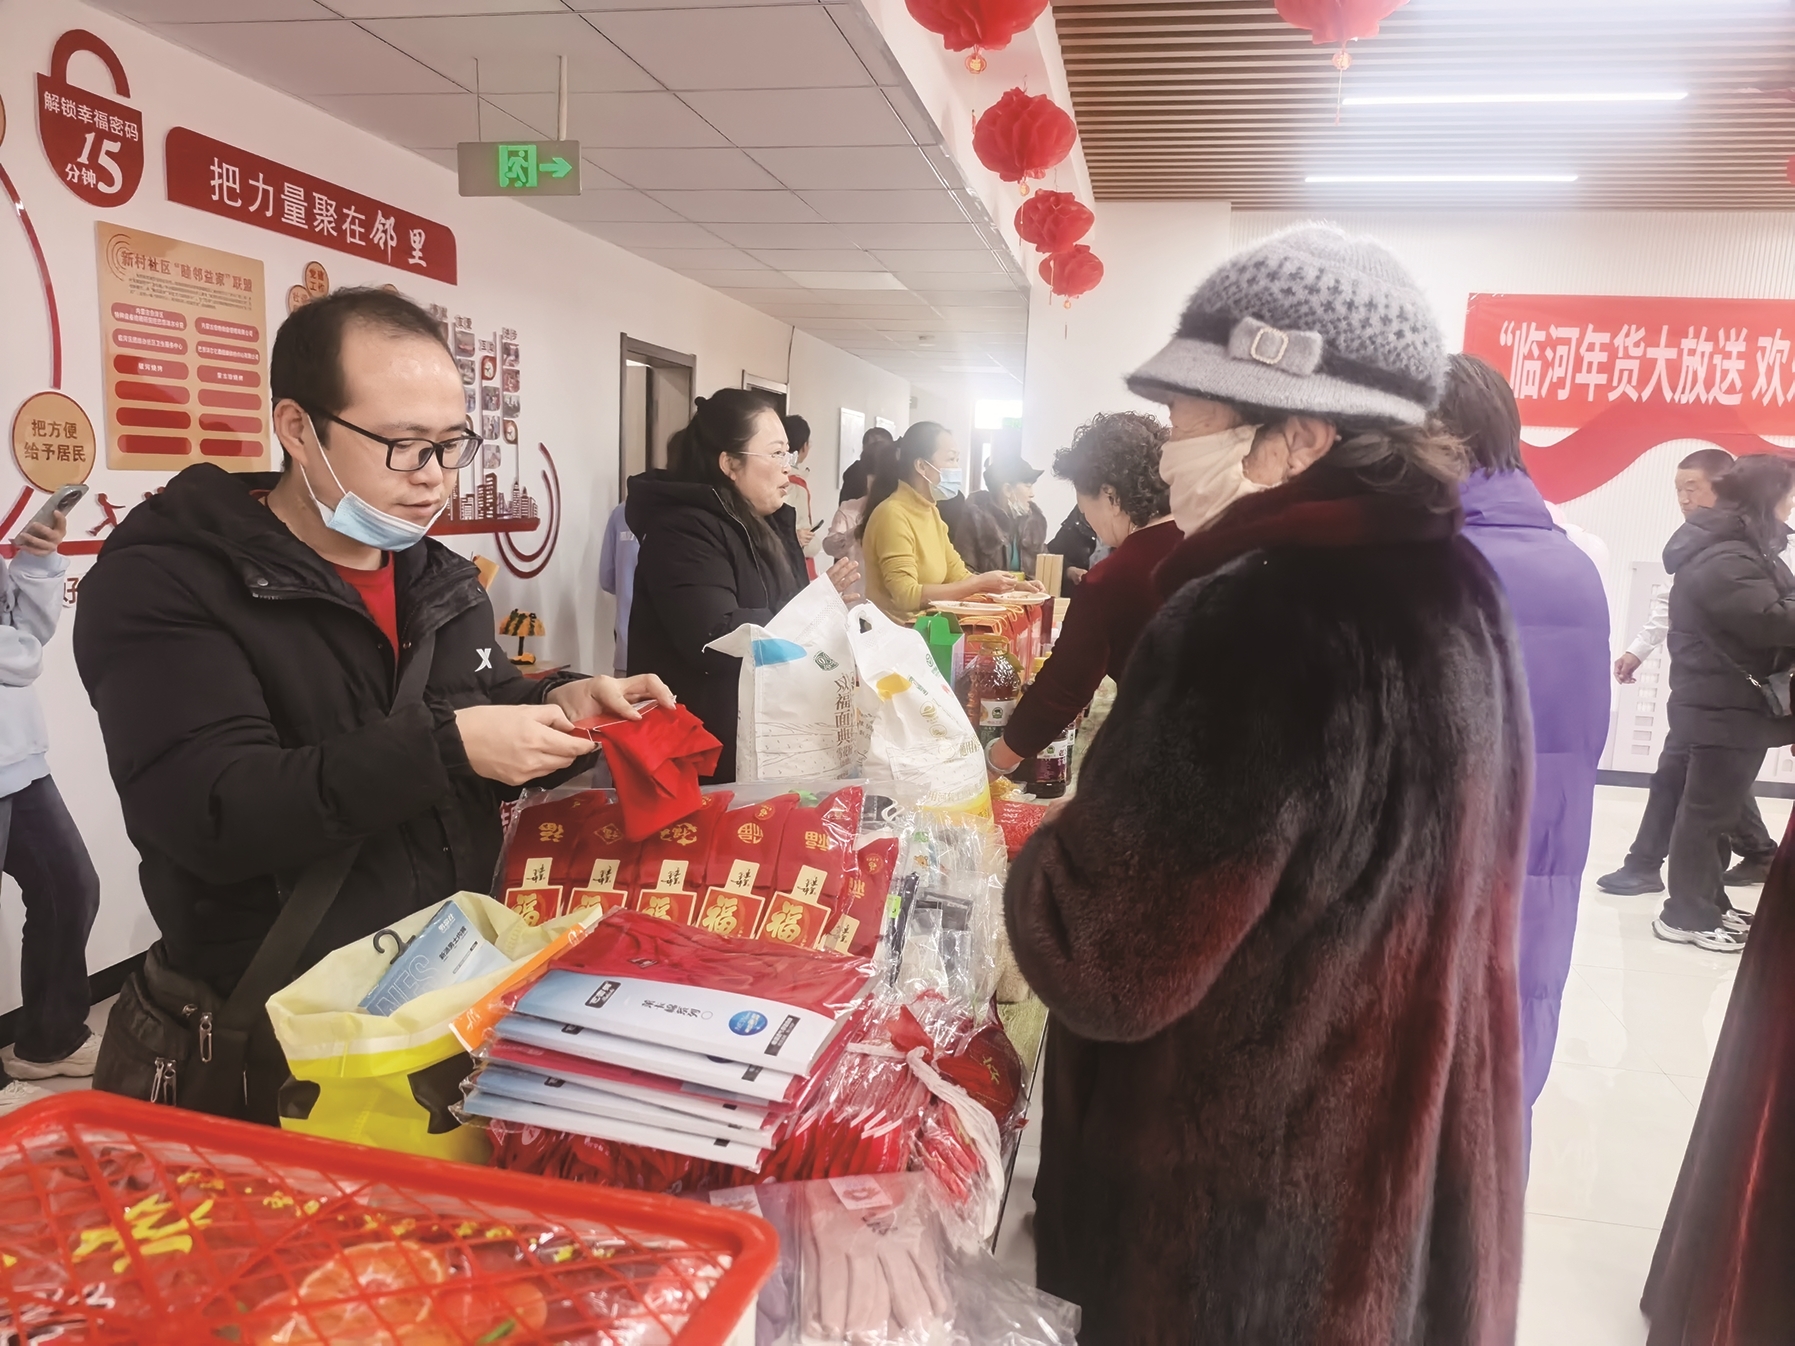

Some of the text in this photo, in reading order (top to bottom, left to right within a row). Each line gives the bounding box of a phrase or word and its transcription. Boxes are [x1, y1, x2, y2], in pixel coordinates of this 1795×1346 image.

[43, 91, 139, 142] 解锁幸福密码
[65, 163, 97, 188] 分钟
[77, 131, 123, 194] 15
[209, 156, 428, 268] 把力量聚在邻里
[1499, 320, 1795, 408] “临河年货大放送 欢
[31, 418, 78, 440] 把方便
[24, 441, 87, 463] 给予居民
[702, 894, 738, 936] 福
[765, 900, 804, 943] 福
